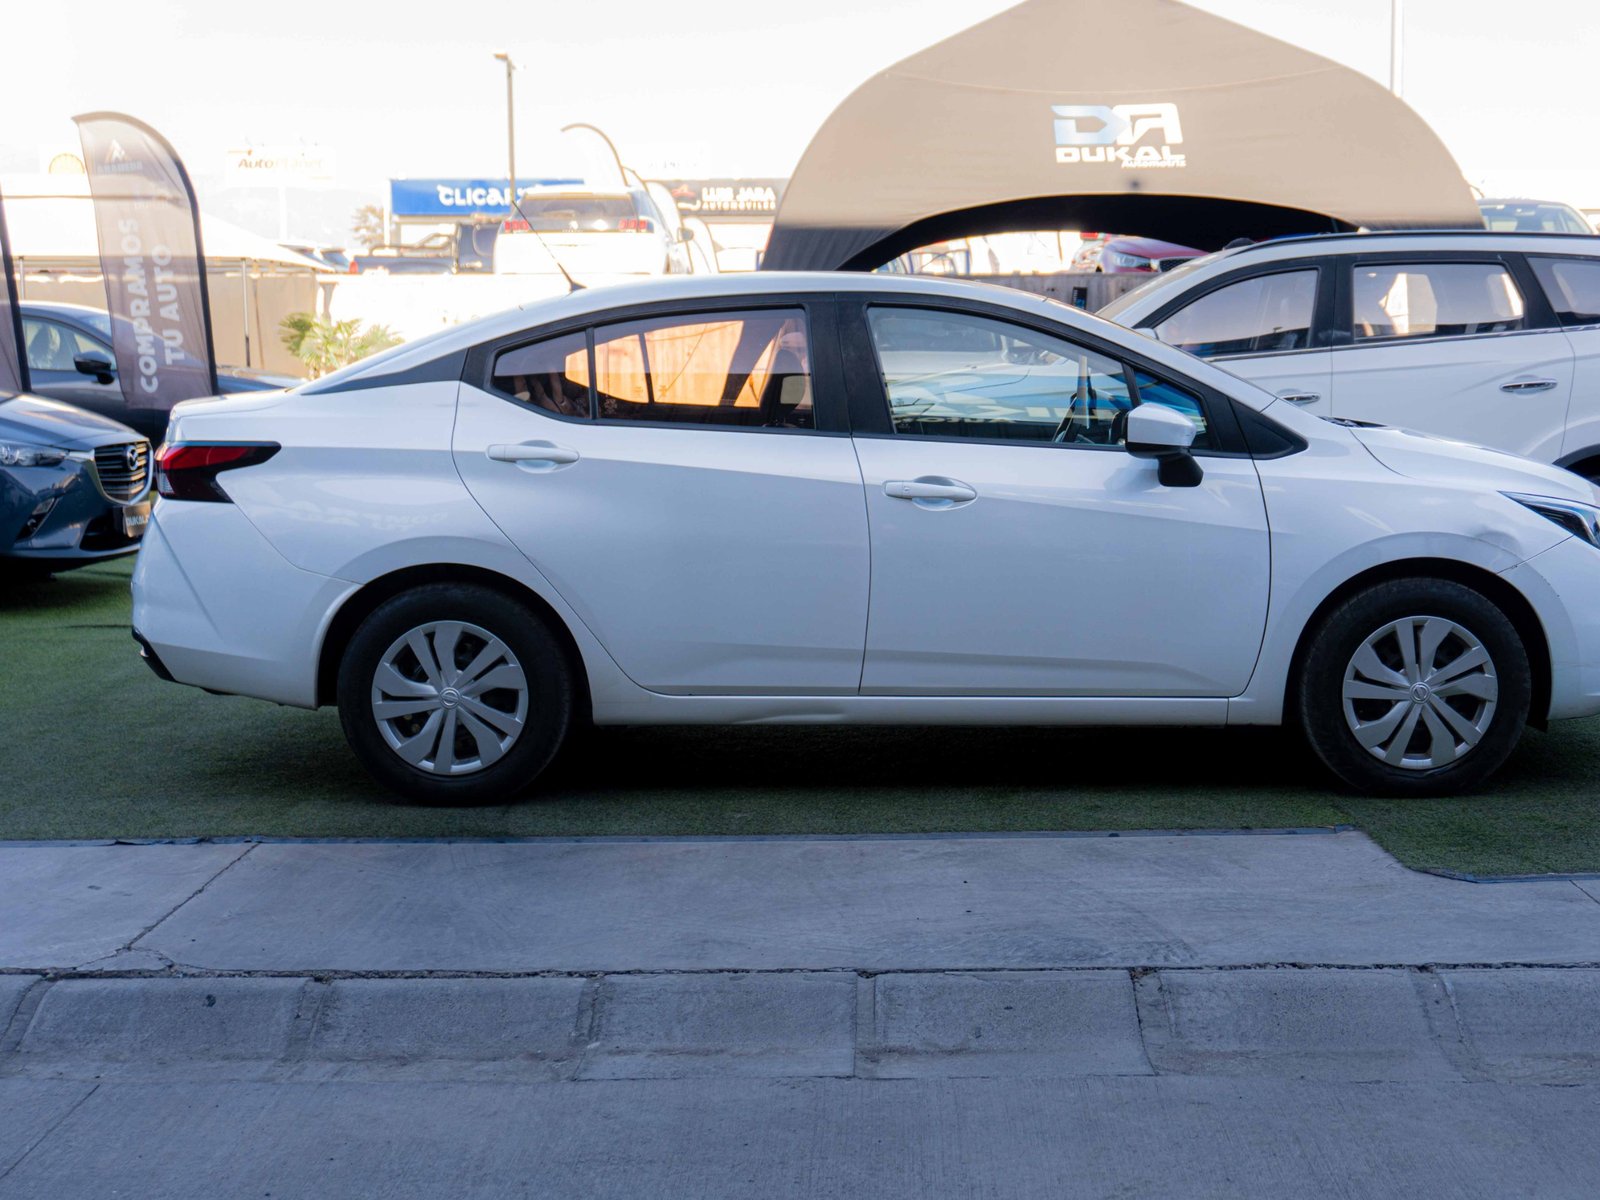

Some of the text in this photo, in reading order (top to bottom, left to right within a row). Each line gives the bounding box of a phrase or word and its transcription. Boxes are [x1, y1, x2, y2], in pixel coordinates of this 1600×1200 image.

[1056, 145, 1186, 163] DUKAL
[118, 218, 159, 394] COMPRAMOS
[151, 243, 186, 366] TU AUTO
